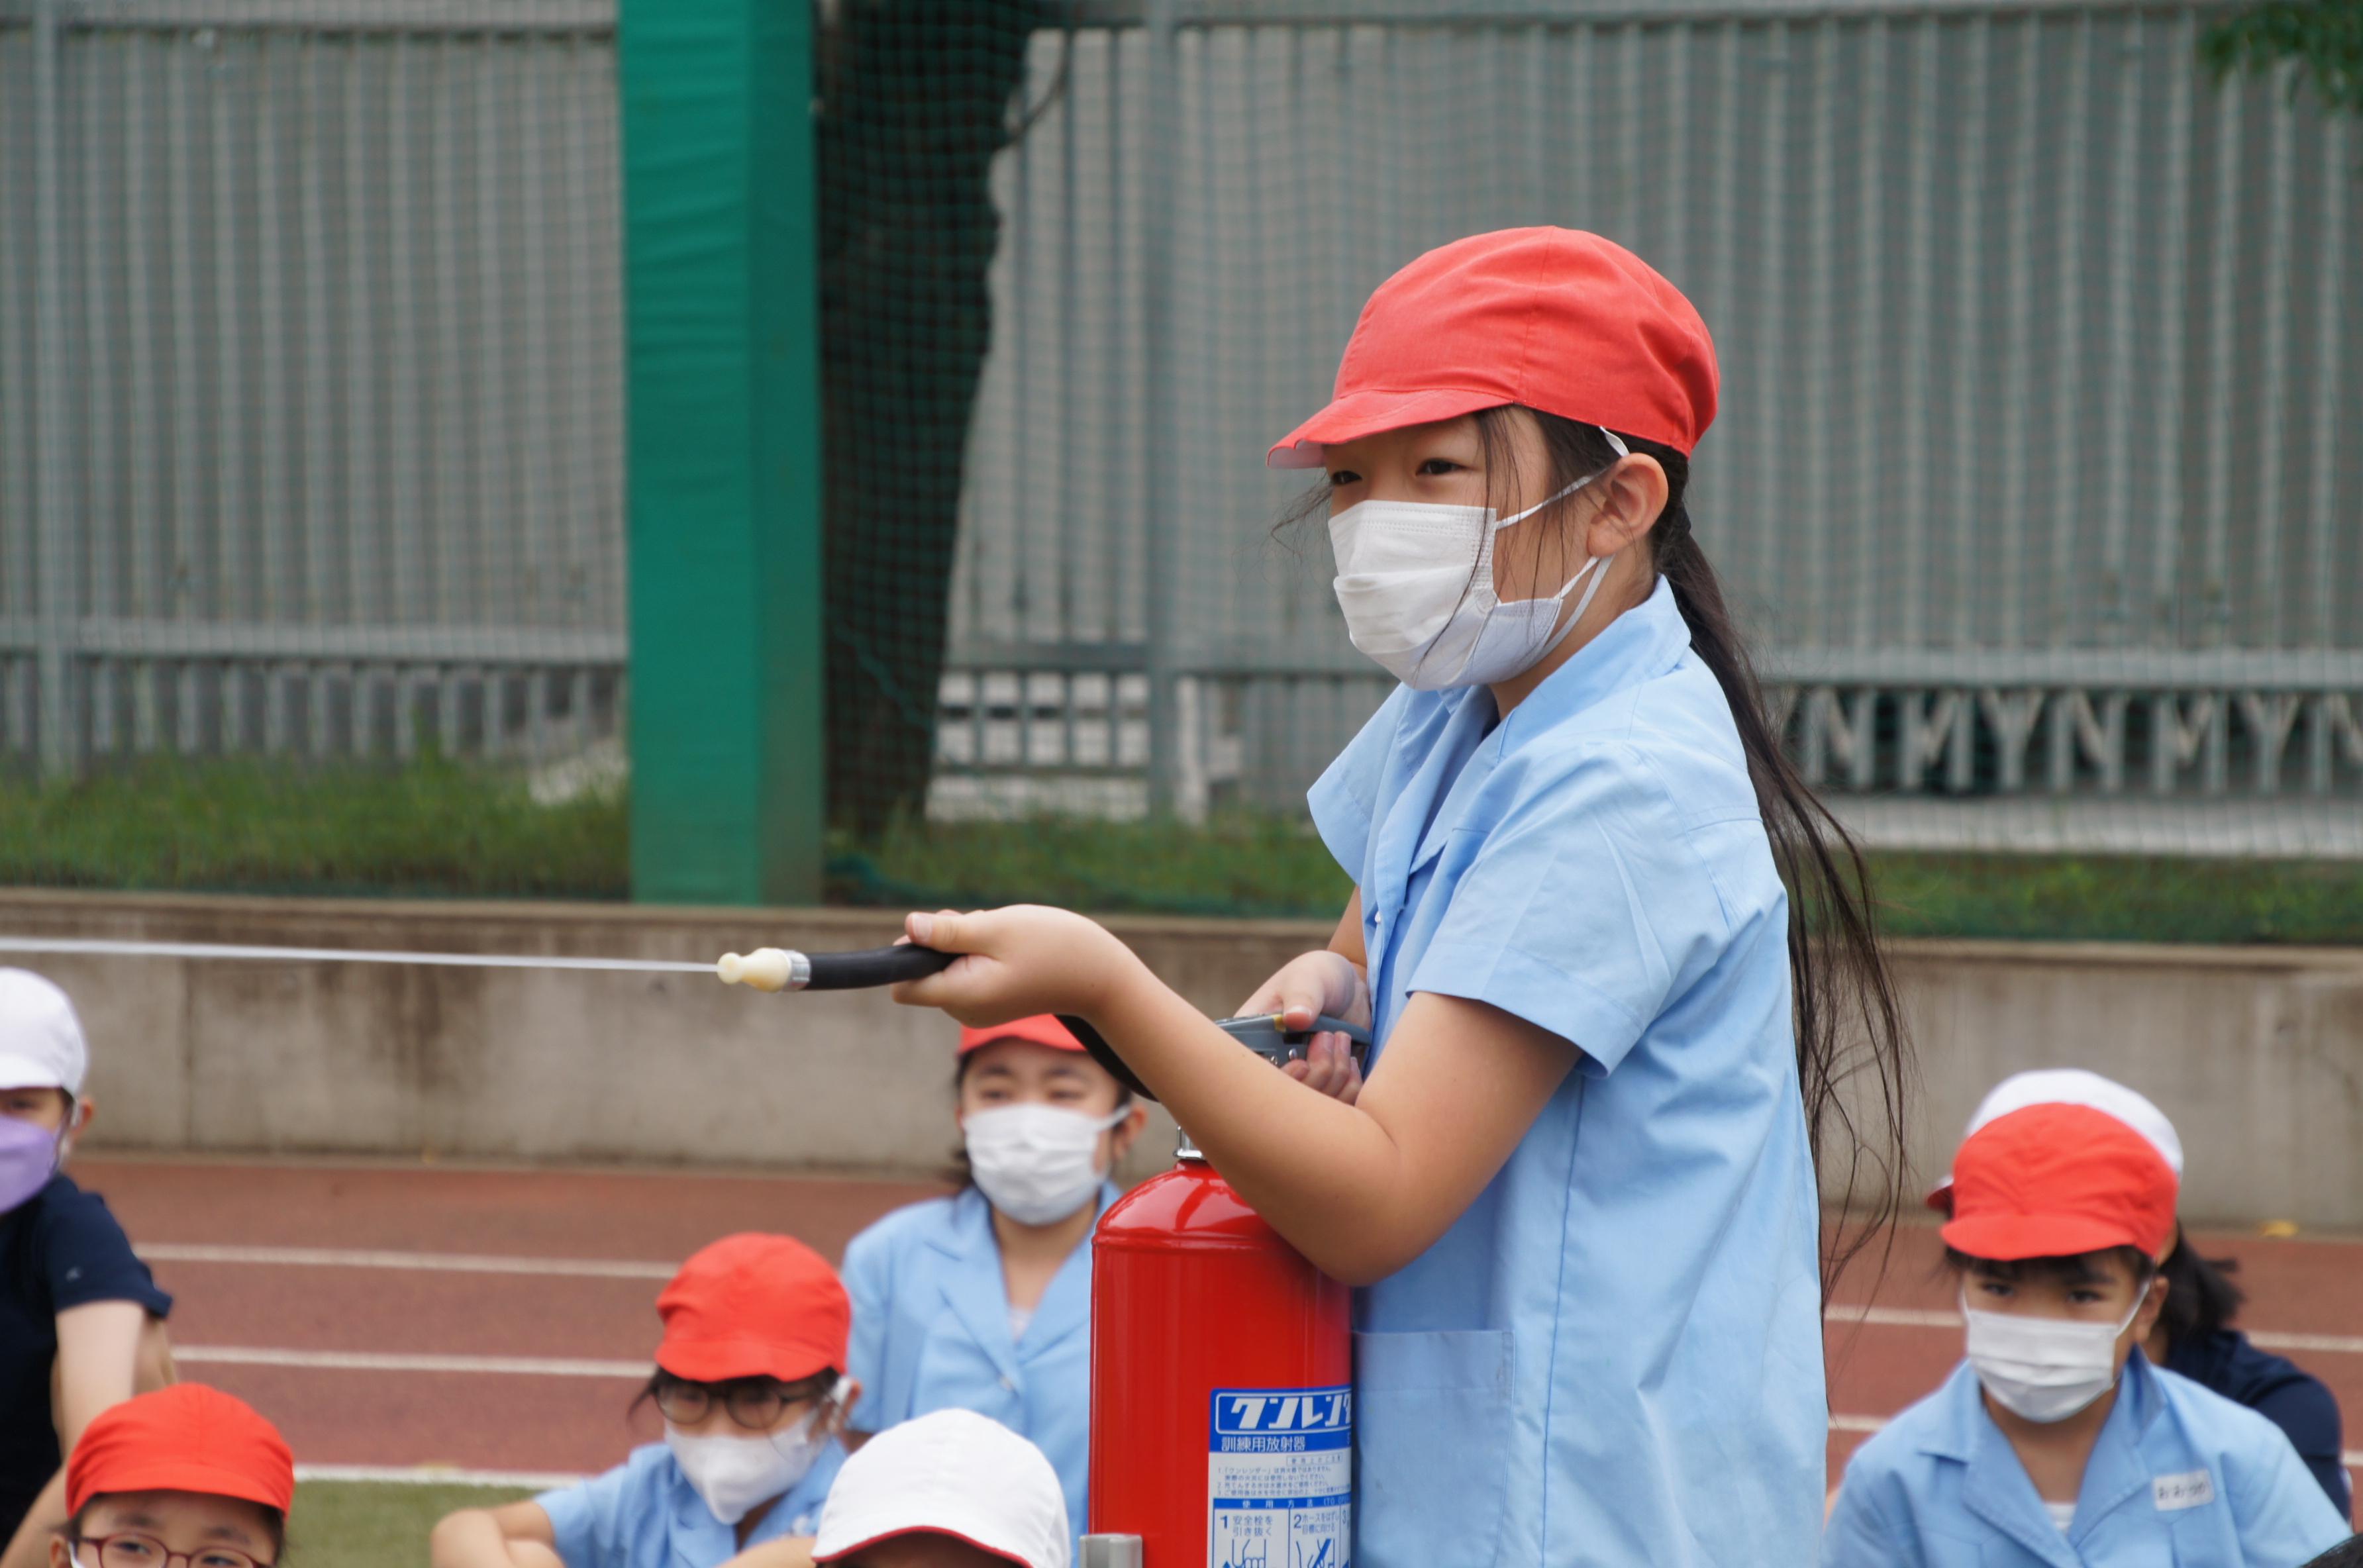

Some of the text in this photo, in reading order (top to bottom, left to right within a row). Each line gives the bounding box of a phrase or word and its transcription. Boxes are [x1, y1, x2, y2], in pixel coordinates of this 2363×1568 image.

[1221, 1436, 1305, 1451] 訓練用放射器
[1220, 1515, 1228, 1529] 1
[1293, 1514, 1302, 1528] 2
